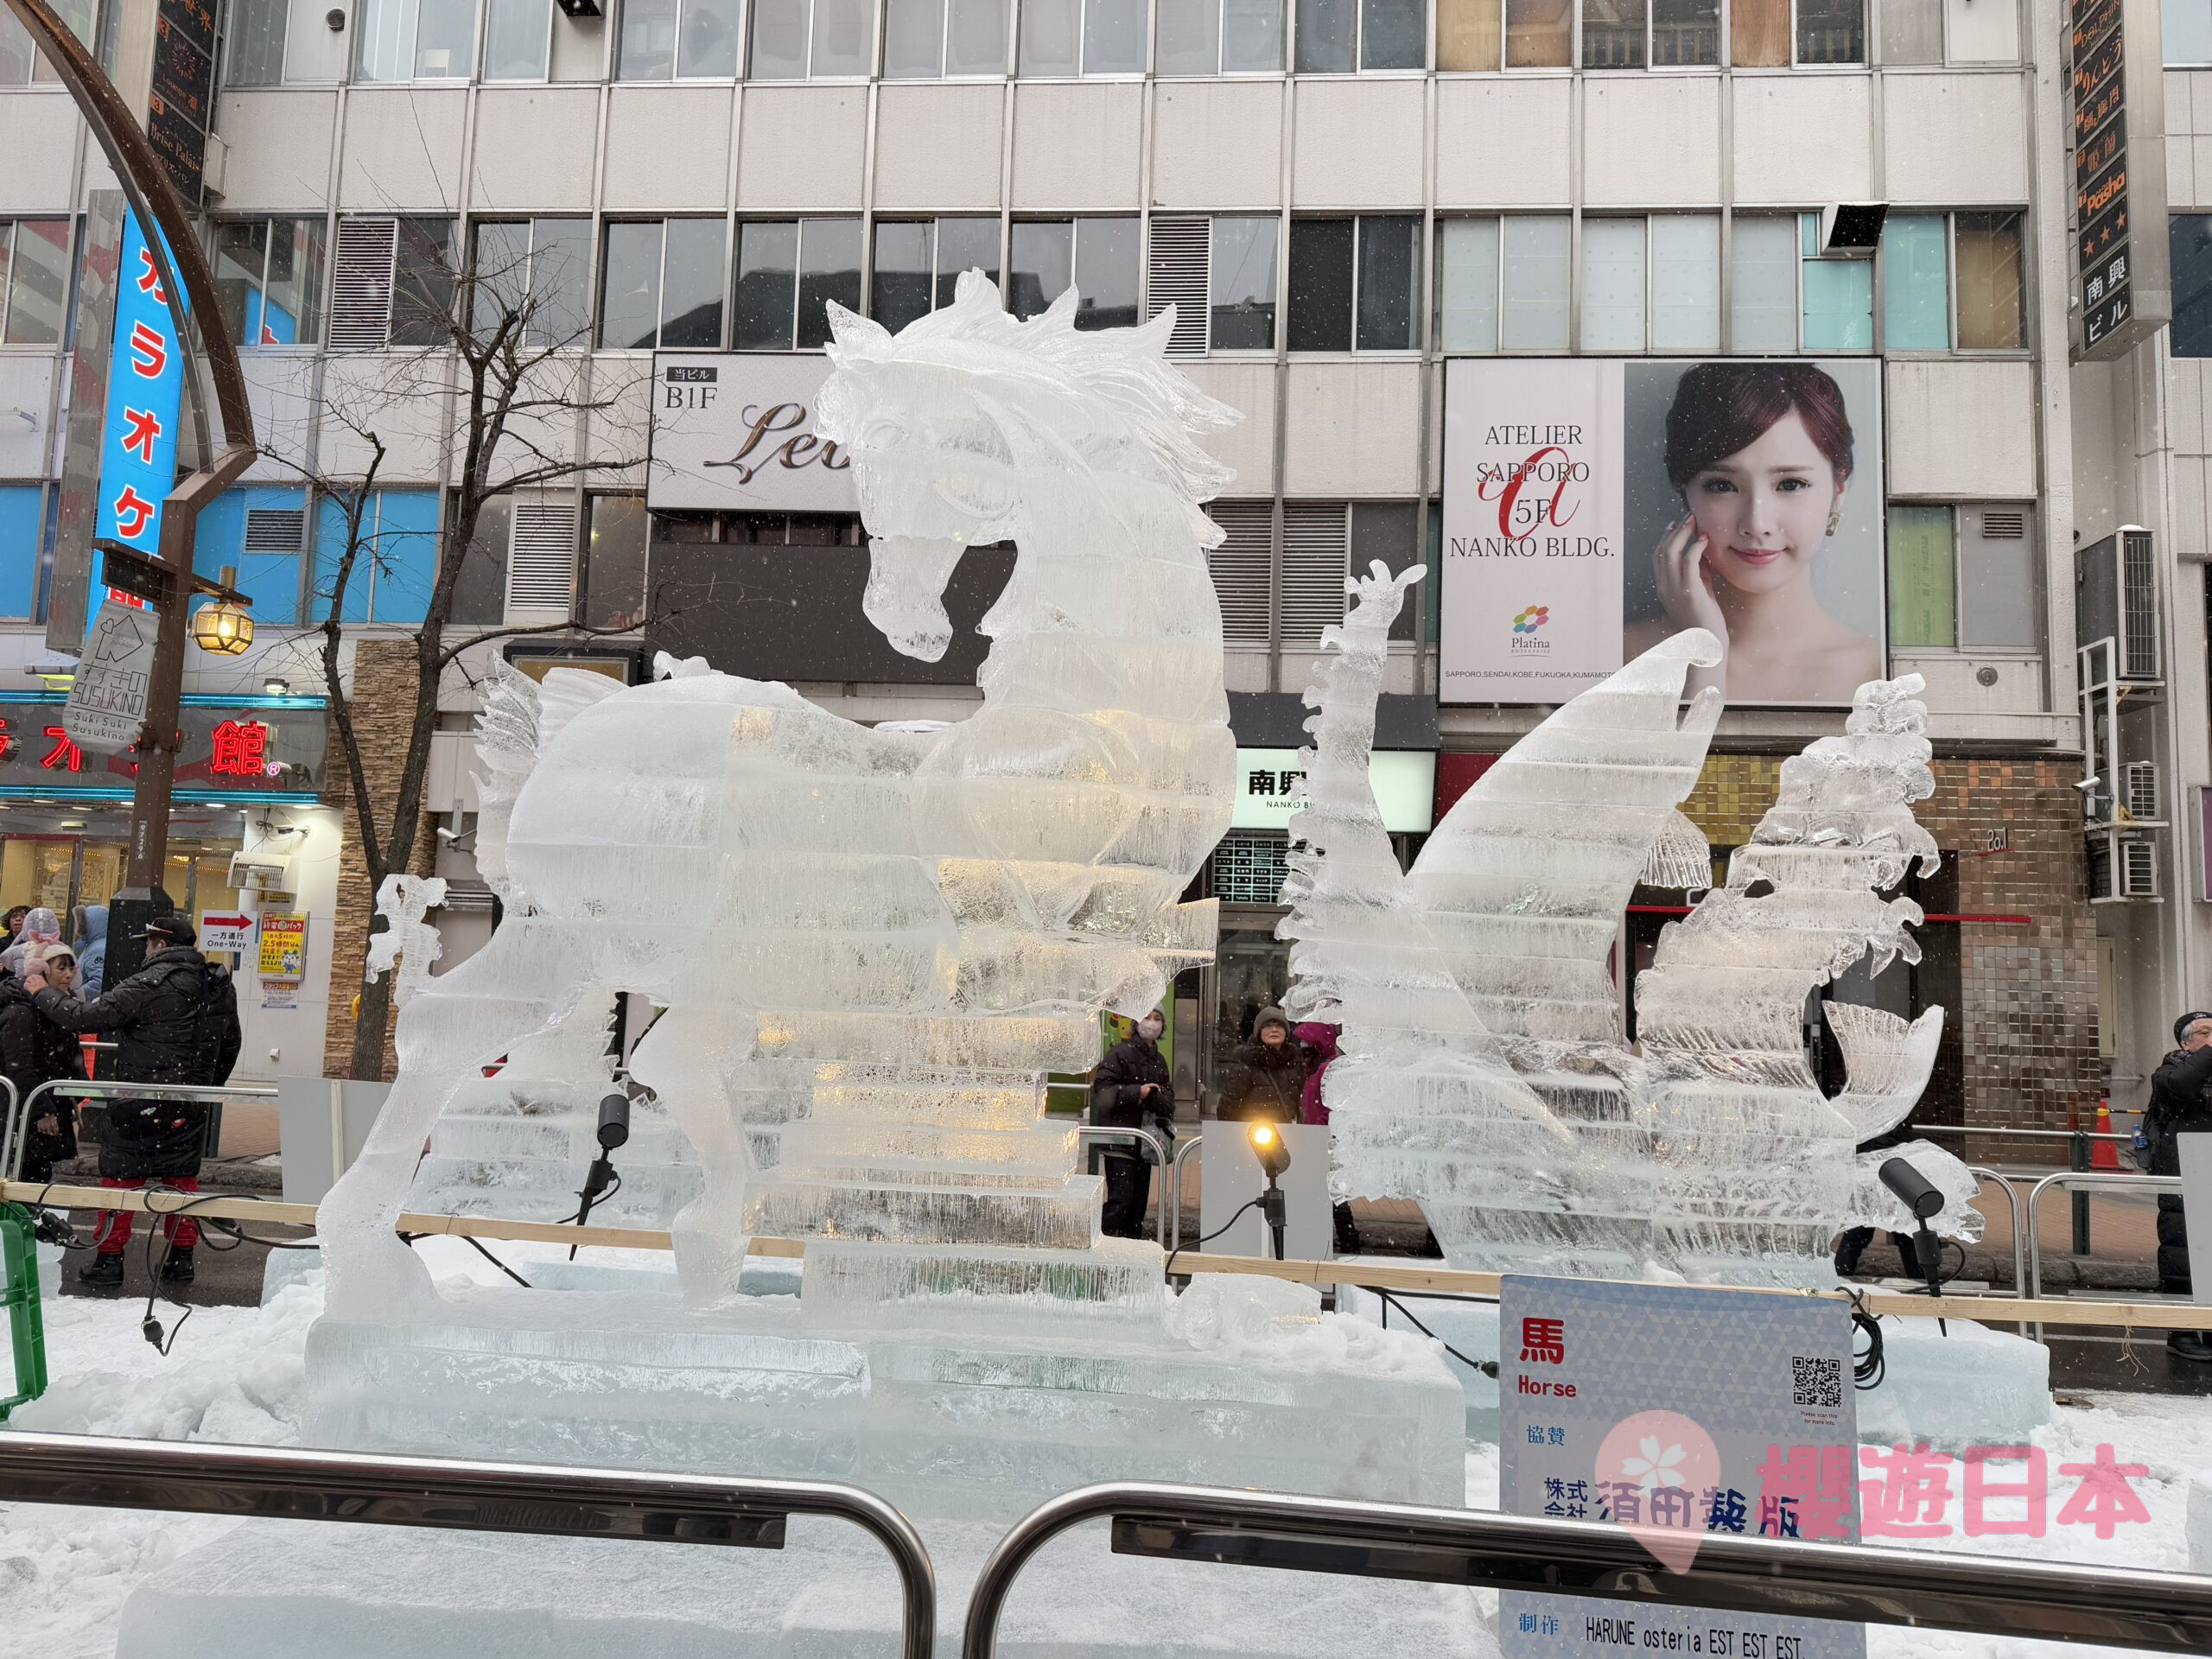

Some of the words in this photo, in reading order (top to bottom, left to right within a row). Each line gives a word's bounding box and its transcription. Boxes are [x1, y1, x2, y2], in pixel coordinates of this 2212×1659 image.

[2088, 170, 2126, 218] Pasha
[2087, 256, 2126, 305] 南興
[2088, 300, 2128, 342] ビル
[675, 368, 710, 381] 当ビル
[109, 245, 170, 609] カラオケ
[1484, 425, 1583, 445] ATELIER
[1477, 462, 1590, 482] SAPPORO
[1515, 499, 1552, 524] 5F
[1450, 537, 1537, 557] NANKO
[1545, 537, 1615, 557] BLDG.
[1511, 637, 1551, 649] Platina
[70, 682, 144, 716] SUSUKINO
[74, 711, 99, 725] Suki
[102, 716, 127, 730] Suki
[72, 723, 124, 741] Susukino
[1266, 800, 1300, 809] NANKO
[207, 940, 247, 950] One-Way
[211, 931, 245, 941] 一方通行
[1520, 1317, 1565, 1365] 馬
[1518, 1374, 1577, 1398] Horse
[1526, 1425, 1566, 1446] 協賛
[1544, 1477, 1588, 1503] 株式
[1519, 1613, 1559, 1636] 制作
[1586, 1616, 1636, 1646] HARUNE
[1643, 1624, 1701, 1654] osteria
[1709, 1629, 1735, 1656] EST
[1742, 1632, 1768, 1659] EST
